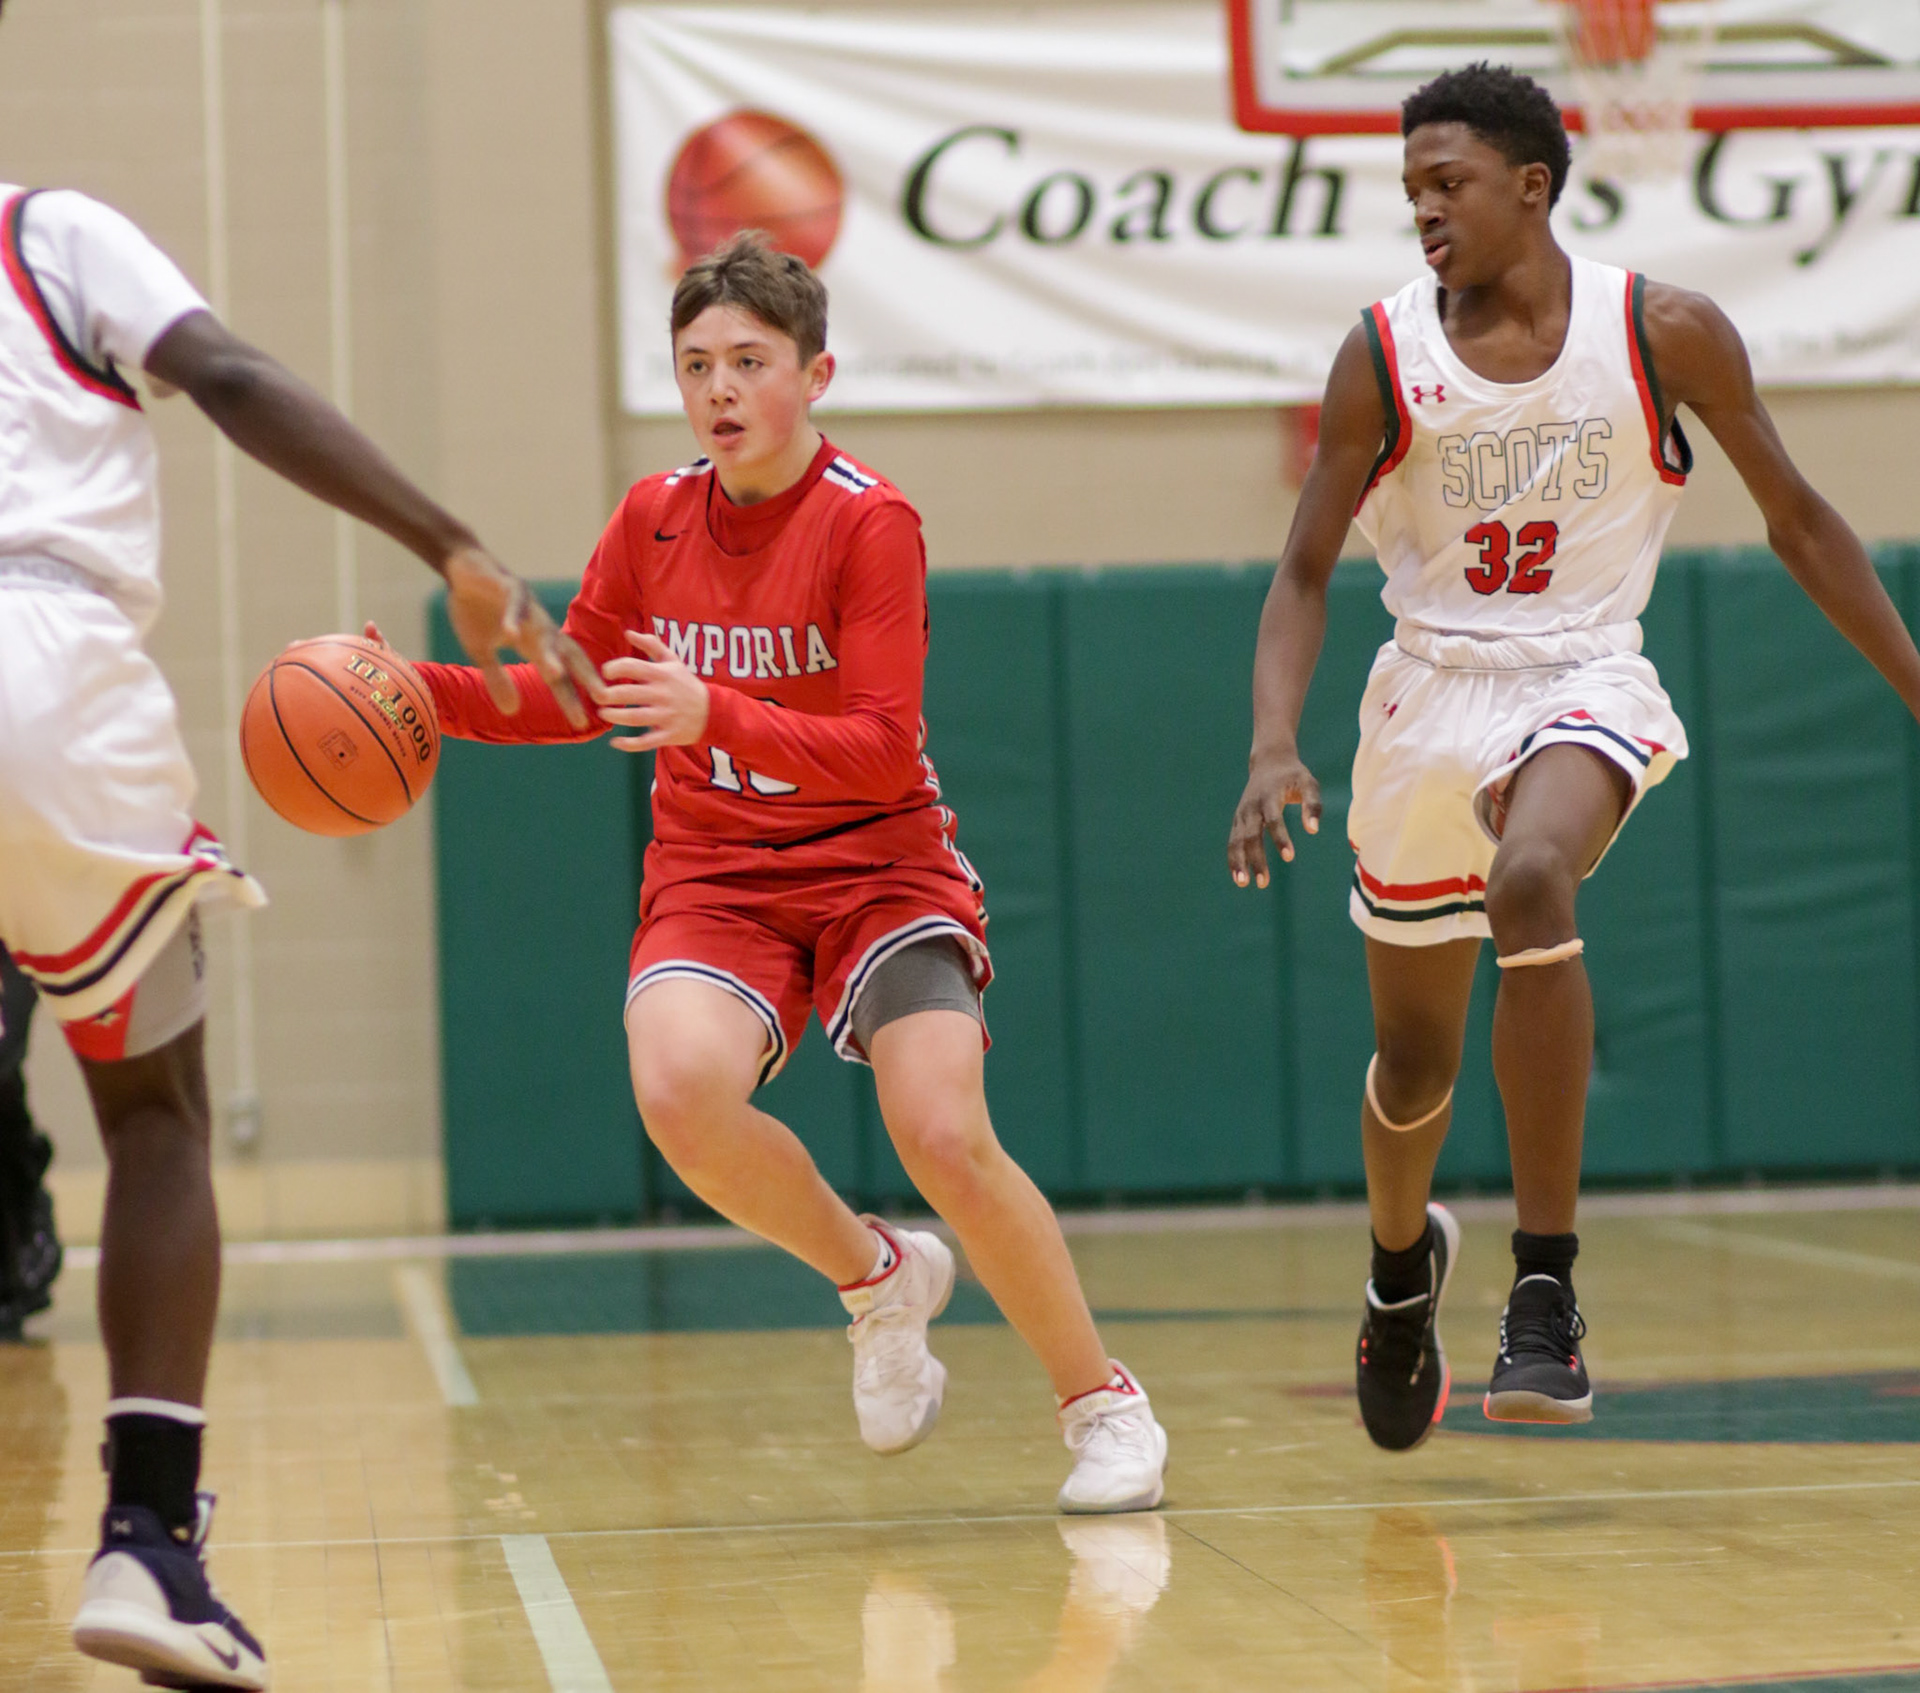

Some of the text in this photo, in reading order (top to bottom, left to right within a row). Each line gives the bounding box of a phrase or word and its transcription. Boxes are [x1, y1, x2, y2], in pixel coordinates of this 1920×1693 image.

[903, 124, 1347, 251] Coach
[1437, 417, 1613, 511] SCOTS
[1464, 520, 1560, 595] 32
